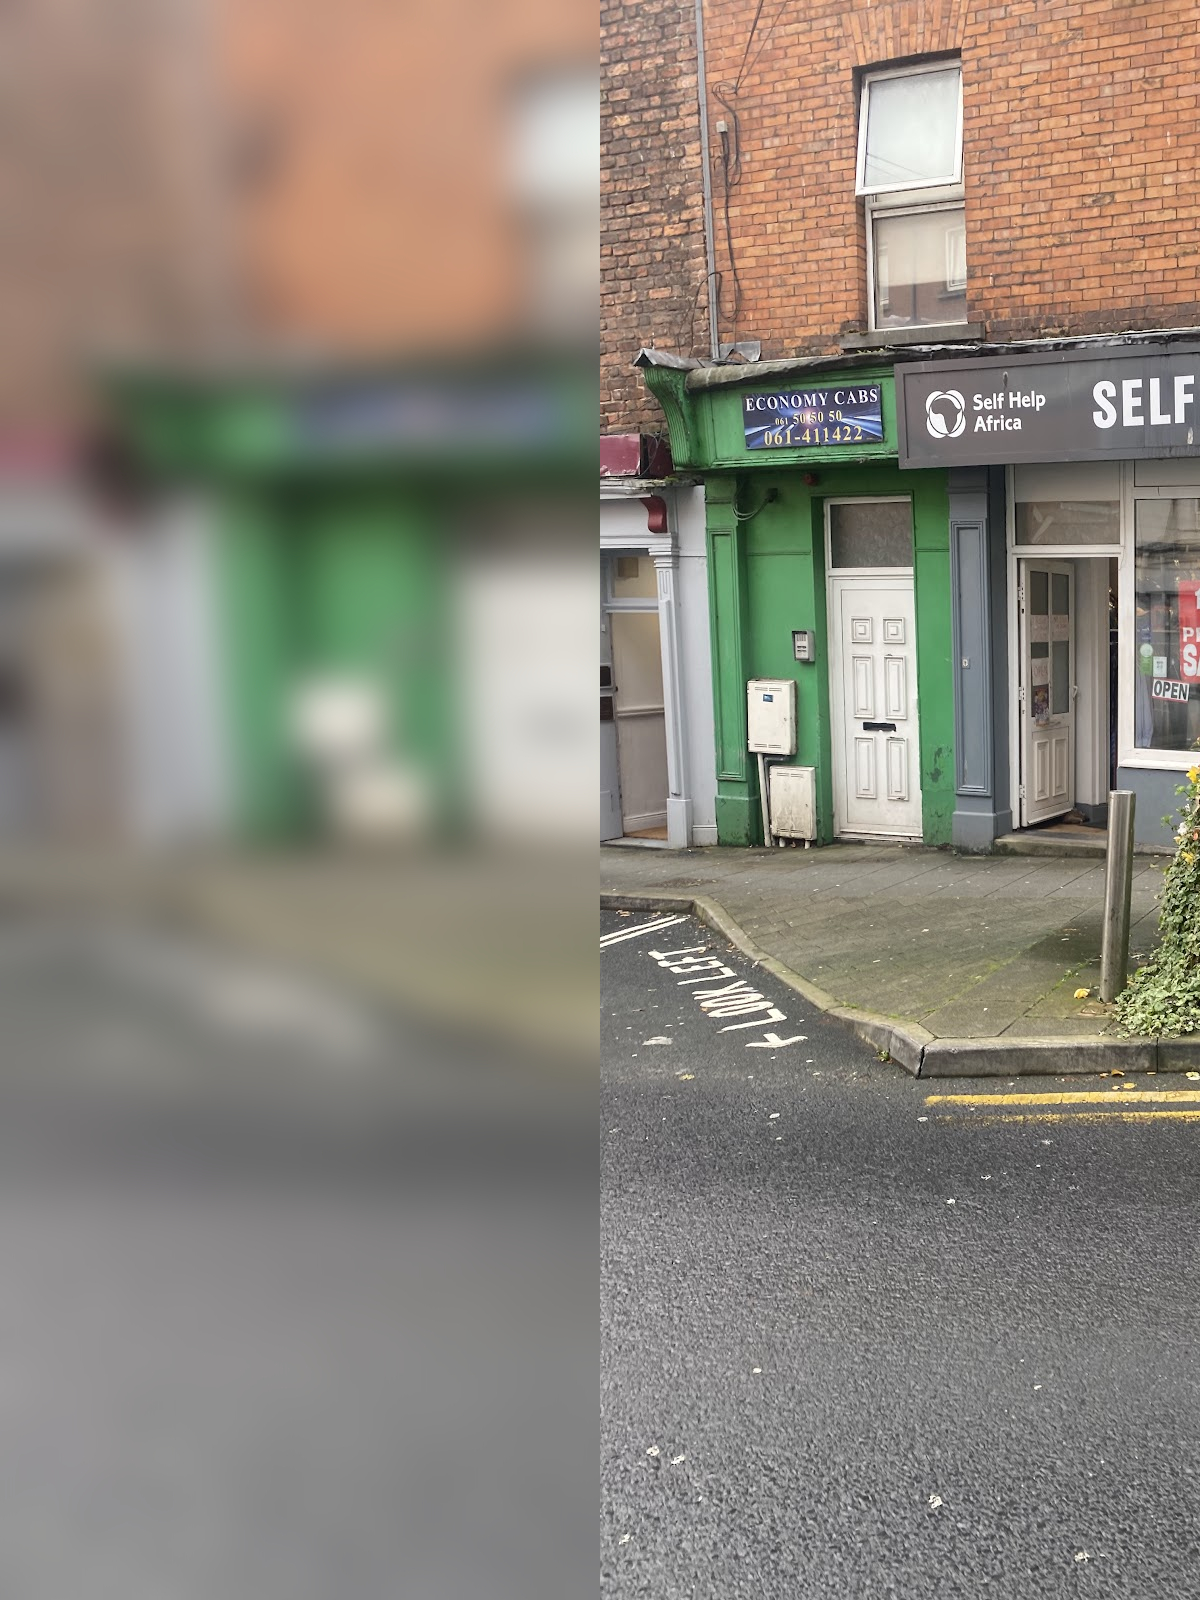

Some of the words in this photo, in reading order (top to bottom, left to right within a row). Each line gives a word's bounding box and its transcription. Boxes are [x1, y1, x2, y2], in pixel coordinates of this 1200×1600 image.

[746, 392, 829, 411] ECONOMY
[835, 388, 878, 405] CABS
[973, 392, 1006, 411] Self
[1009, 391, 1046, 412] Help
[1092, 375, 1195, 429] SELF
[775, 417, 788, 426] 061
[793, 413, 806, 424] 50
[810, 411, 824, 423] 50
[828, 410, 842, 422] 50
[973, 414, 1022, 433] Africa
[764, 425, 863, 446] 061-411422
[1154, 680, 1189, 700] OPEN
[647, 946, 738, 986] LEFT
[691, 980, 788, 1034] LOOK
